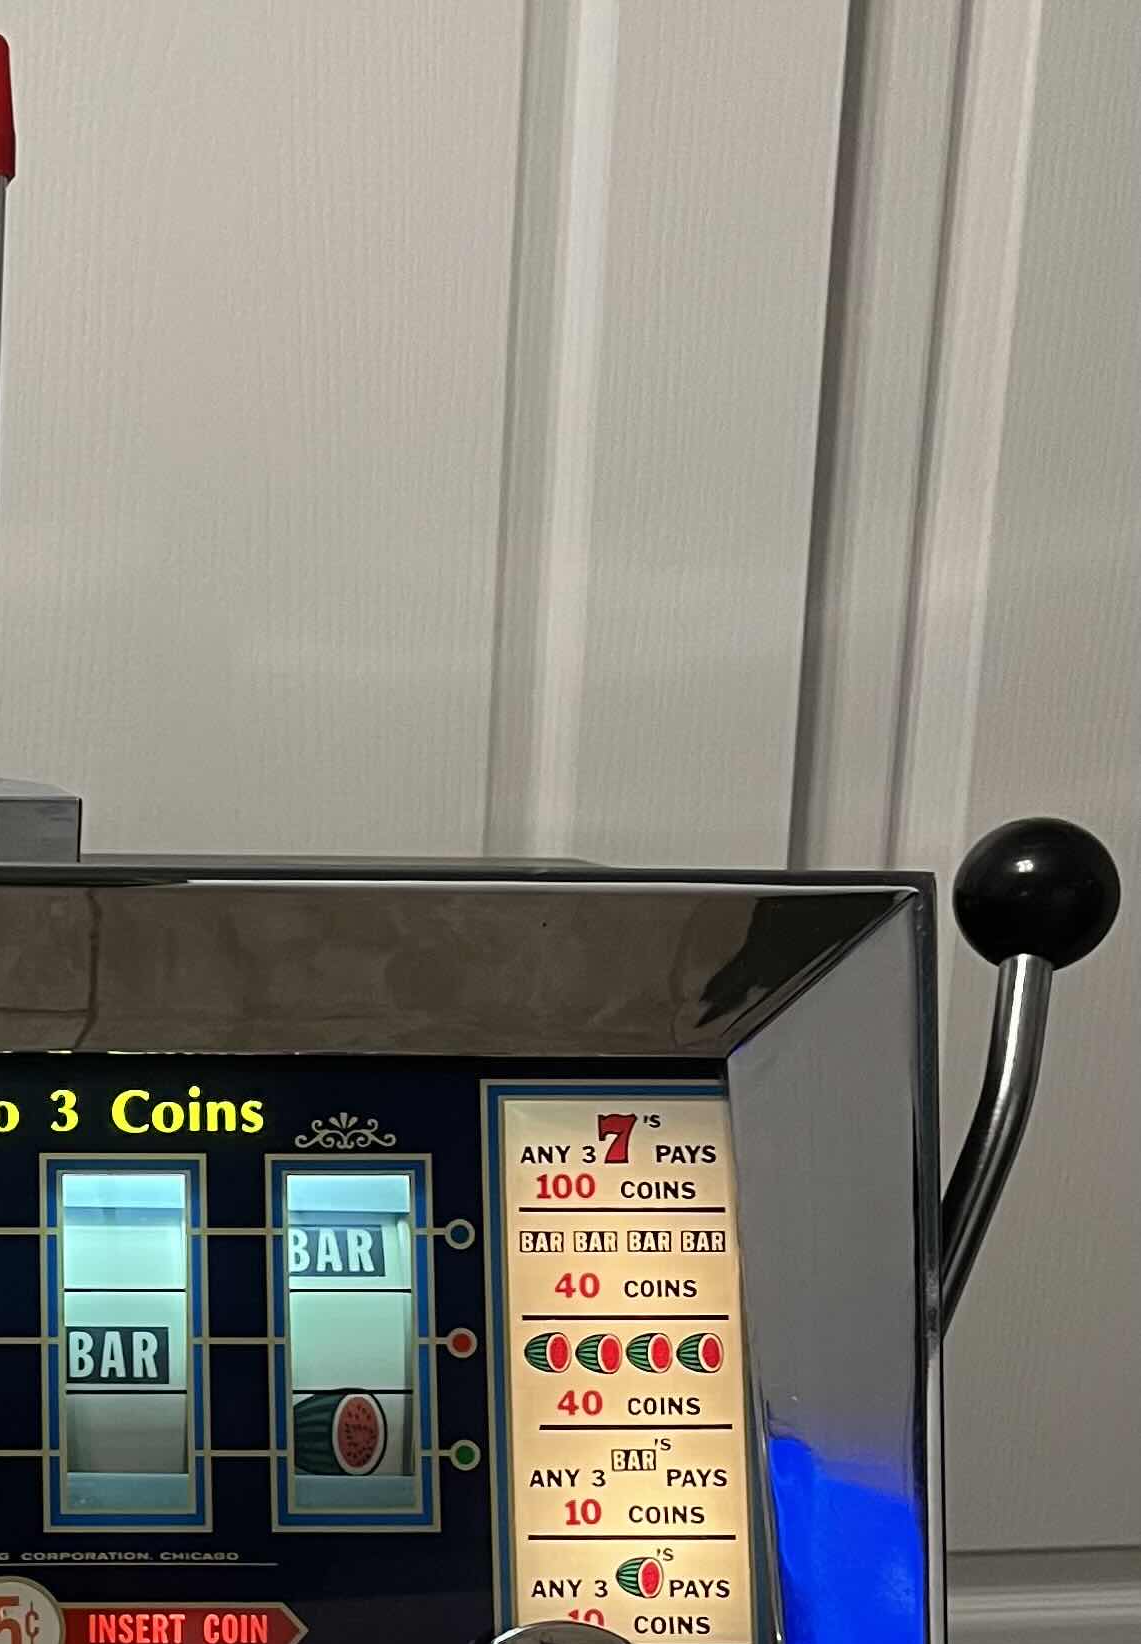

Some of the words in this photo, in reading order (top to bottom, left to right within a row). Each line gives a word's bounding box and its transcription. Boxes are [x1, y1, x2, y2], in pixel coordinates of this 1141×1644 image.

[50, 1089, 79, 1132] 3
[111, 1085, 264, 1134] Coins
[520, 1145, 570, 1163] ANY
[582, 1145, 596, 1163] 3
[655, 1145, 716, 1163] PAYS
[537, 1173, 596, 1199] 100
[620, 1181, 696, 1199] COINS
[286, 1227, 376, 1278] BAR
[521, 1232, 563, 1252] BAR
[575, 1232, 617, 1252] BAR
[628, 1232, 671, 1252] BAR
[682, 1232, 725, 1252] BAR
[554, 1273, 600, 1298] 40
[624, 1280, 698, 1297] COINS
[68, 1330, 160, 1380] BAR
[557, 1390, 603, 1416] 40
[628, 1397, 701, 1415] COINS
[529, 1469, 580, 1487] ANY
[592, 1469, 606, 1487] 3
[666, 1469, 727, 1487] PAYS
[565, 1499, 602, 1525] 10
[628, 1506, 705, 1524] COINS
[159, 1552, 240, 1561] CHICAGO
[531, 1580, 582, 1598] ANY
[594, 1580, 608, 1598] 3
[669, 1580, 730, 1598] PAYS
[88, 1614, 185, 1644] INSERT
[203, 1614, 269, 1644] COIN
[634, 1616, 711, 1635] COINS
